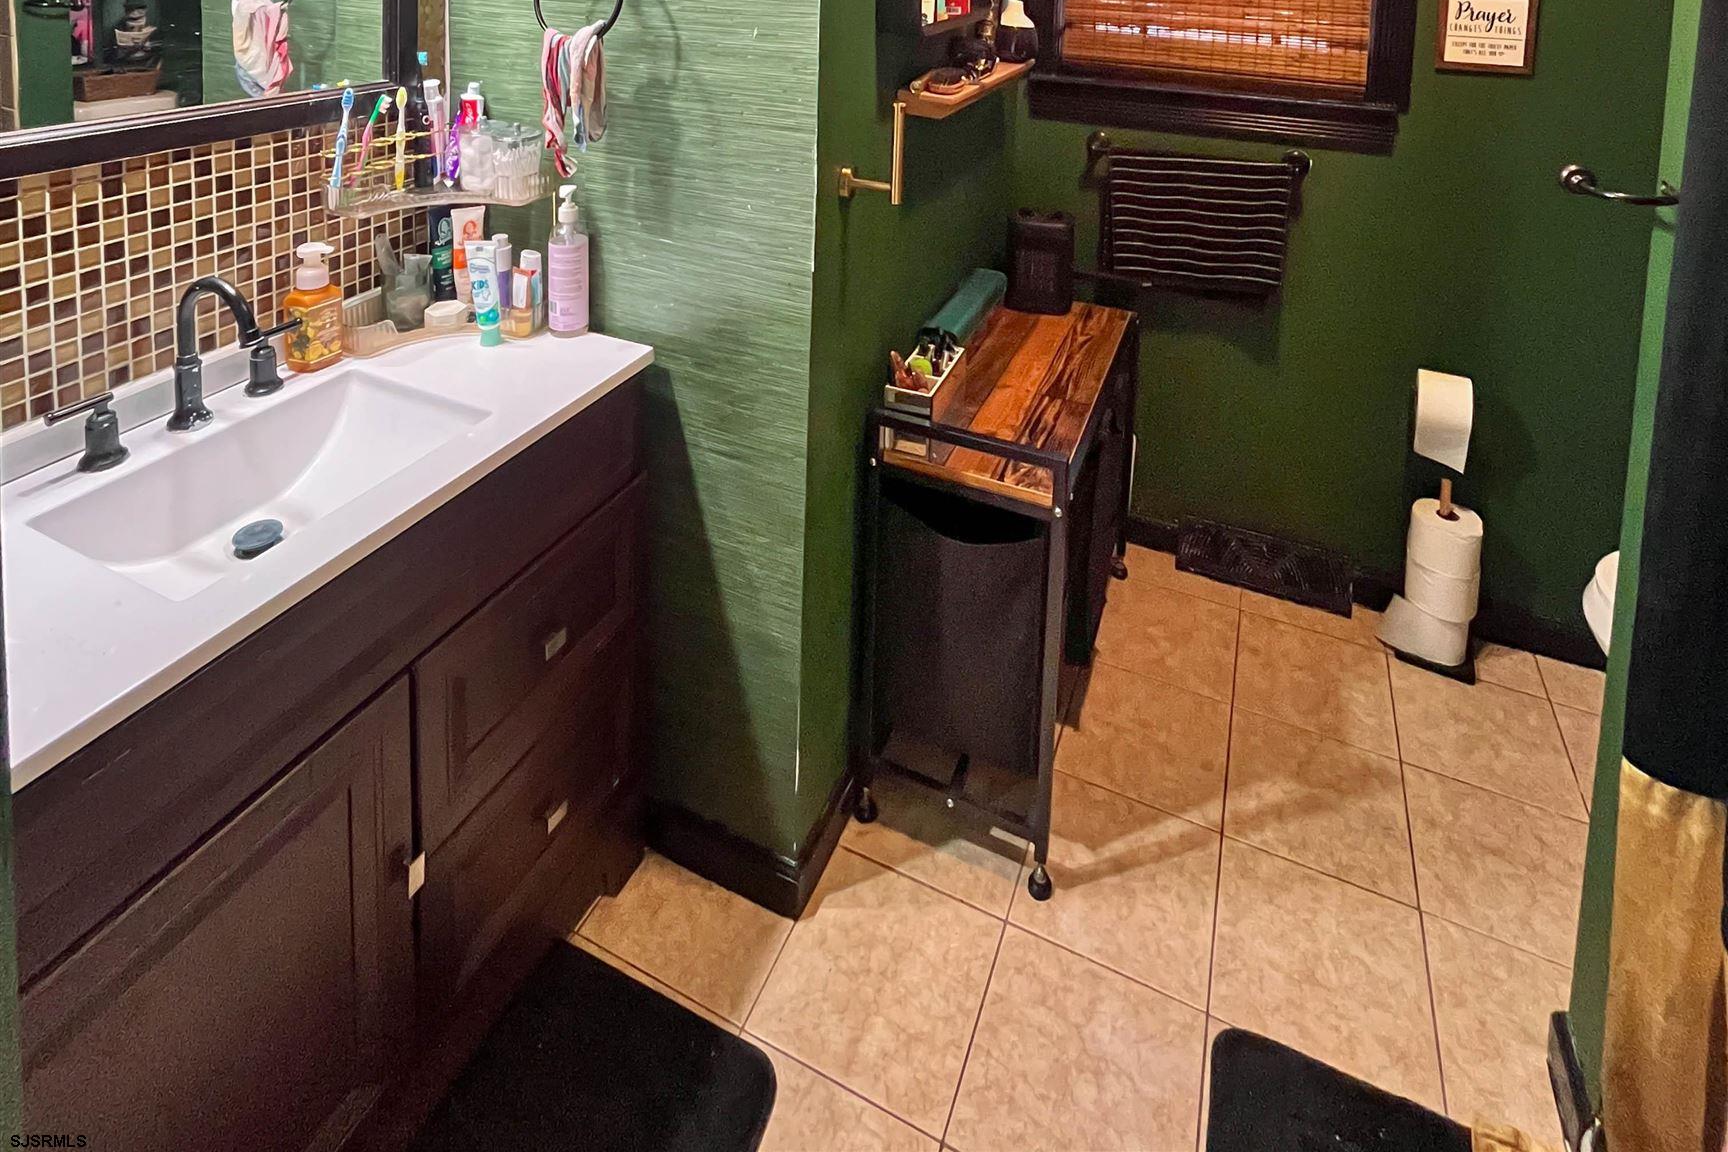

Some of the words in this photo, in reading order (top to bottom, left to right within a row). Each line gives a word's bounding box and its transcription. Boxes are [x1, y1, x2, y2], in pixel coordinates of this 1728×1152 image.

[1455, 1, 1516, 33] Prayer
[1449, 23, 1482, 33] CHANGES
[1494, 26, 1522, 35] THINGS
[471, 279, 490, 291] KIDS
